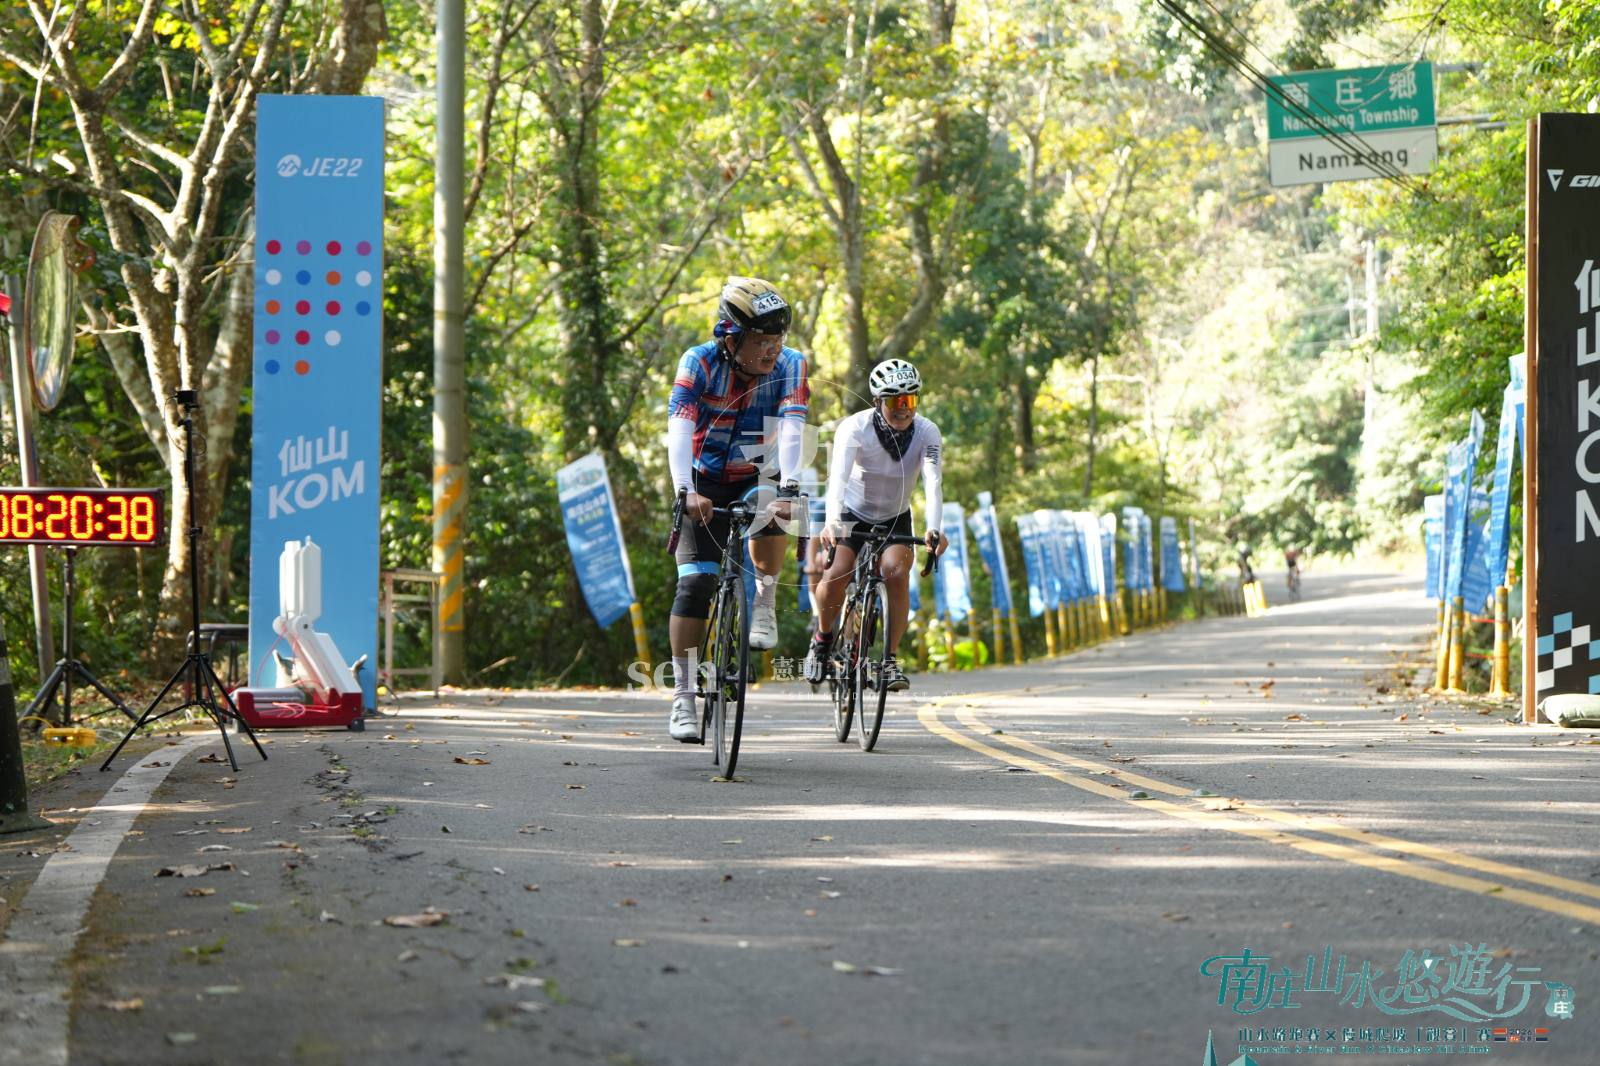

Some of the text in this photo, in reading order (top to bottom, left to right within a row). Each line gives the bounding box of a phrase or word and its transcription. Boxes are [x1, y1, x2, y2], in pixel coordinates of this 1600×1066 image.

[1360, 106, 1419, 126] Township
[303, 157, 363, 177] JE22
[278, 426, 348, 477] 仙山
[269, 460, 364, 519] KOM
